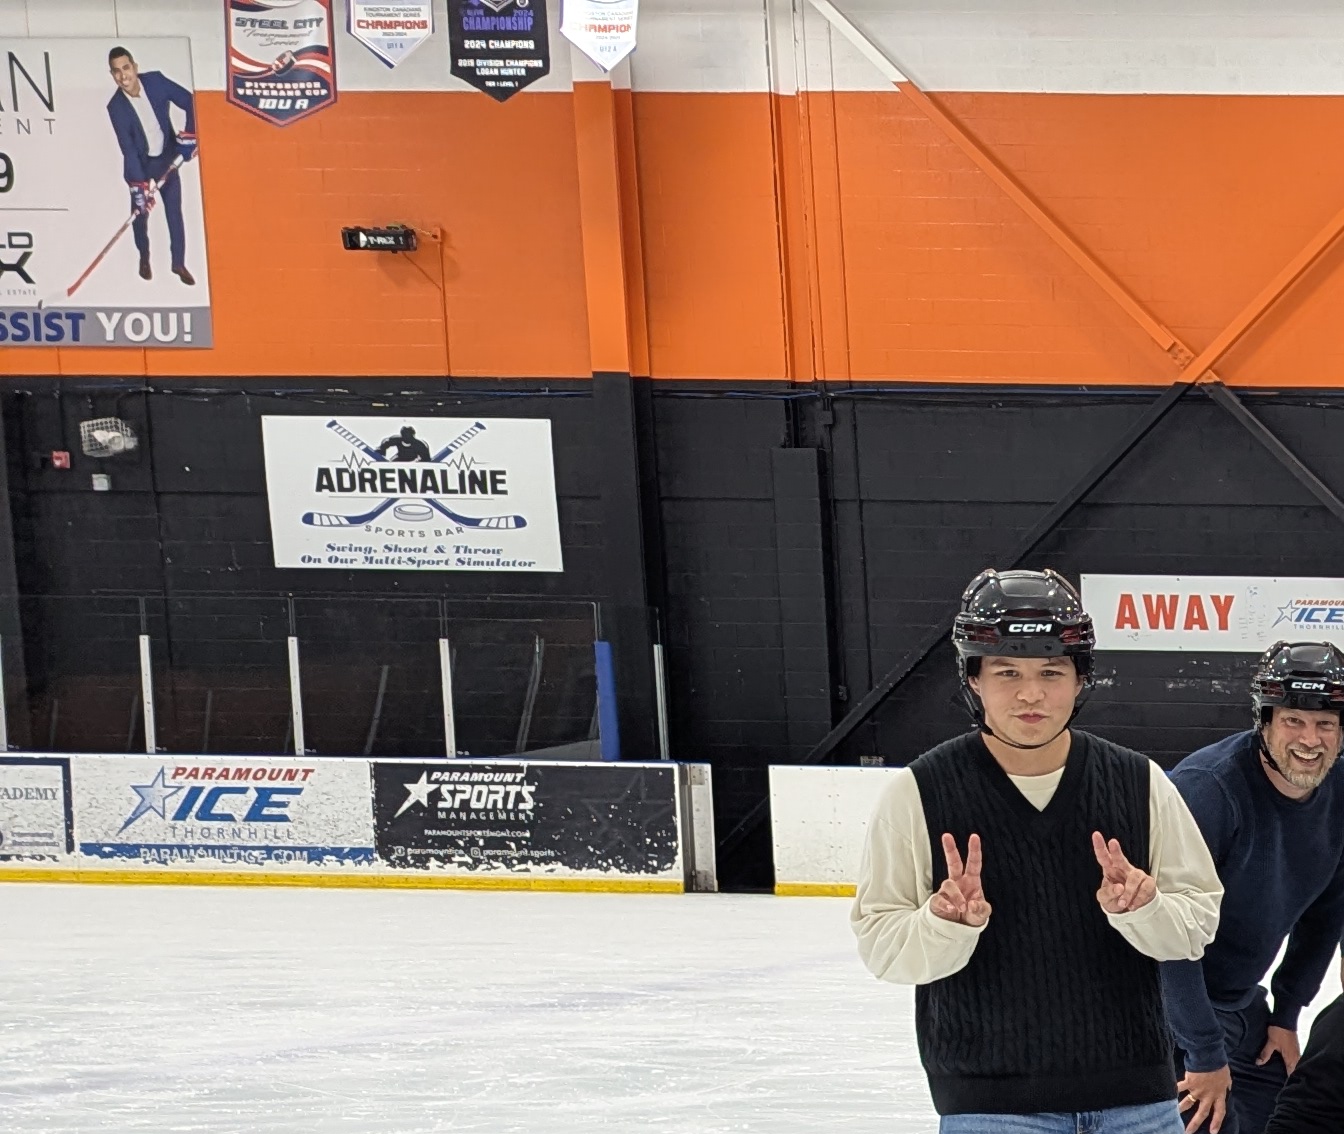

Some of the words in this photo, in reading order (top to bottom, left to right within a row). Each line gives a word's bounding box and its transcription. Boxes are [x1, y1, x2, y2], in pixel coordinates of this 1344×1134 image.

[235, 17, 289, 29] STEEL
[293, 17, 324, 29] CITY
[356, 19, 428, 30] CHAMPIONS
[462, 16, 534, 31] CHAMPIONSHIP
[463, 40, 487, 49] 2024
[488, 40, 535, 49] CHAMPIONS
[0, 51, 55, 112] N
[244, 81, 322, 89] PITTSBURGH
[236, 88, 302, 97] VETERANS
[304, 88, 328, 97] CUP
[294, 98, 310, 110] A
[0, 117, 56, 135] NT
[0, 231, 34, 249] D
[96, 311, 193, 343] YOU!
[315, 467, 509, 496] ADRENALINE
[364, 524, 426, 538] SPORTS
[434, 525, 465, 538] BAR
[325, 542, 378, 555] Swing,
[382, 543, 429, 554] Shoot
[452, 544, 505, 555] Throw
[301, 555, 323, 565] On
[327, 555, 358, 565] Our
[361, 555, 451, 568] Multi-Sport
[454, 555, 537, 568] Simulator
[1114, 593, 1235, 631] AWAY
[1008, 623, 1052, 633] CCM
[1291, 681, 1325, 690] CCM
[171, 766, 316, 782] PARAMOUNT
[430, 772, 525, 783] PARAMOUNT
[0, 787, 59, 801] ADEMY
[437, 784, 536, 809] SPORTS
[171, 786, 304, 822] ICE
[438, 810, 535, 821] MANAGEMENT
[171, 827, 294, 840] THORNHILL
